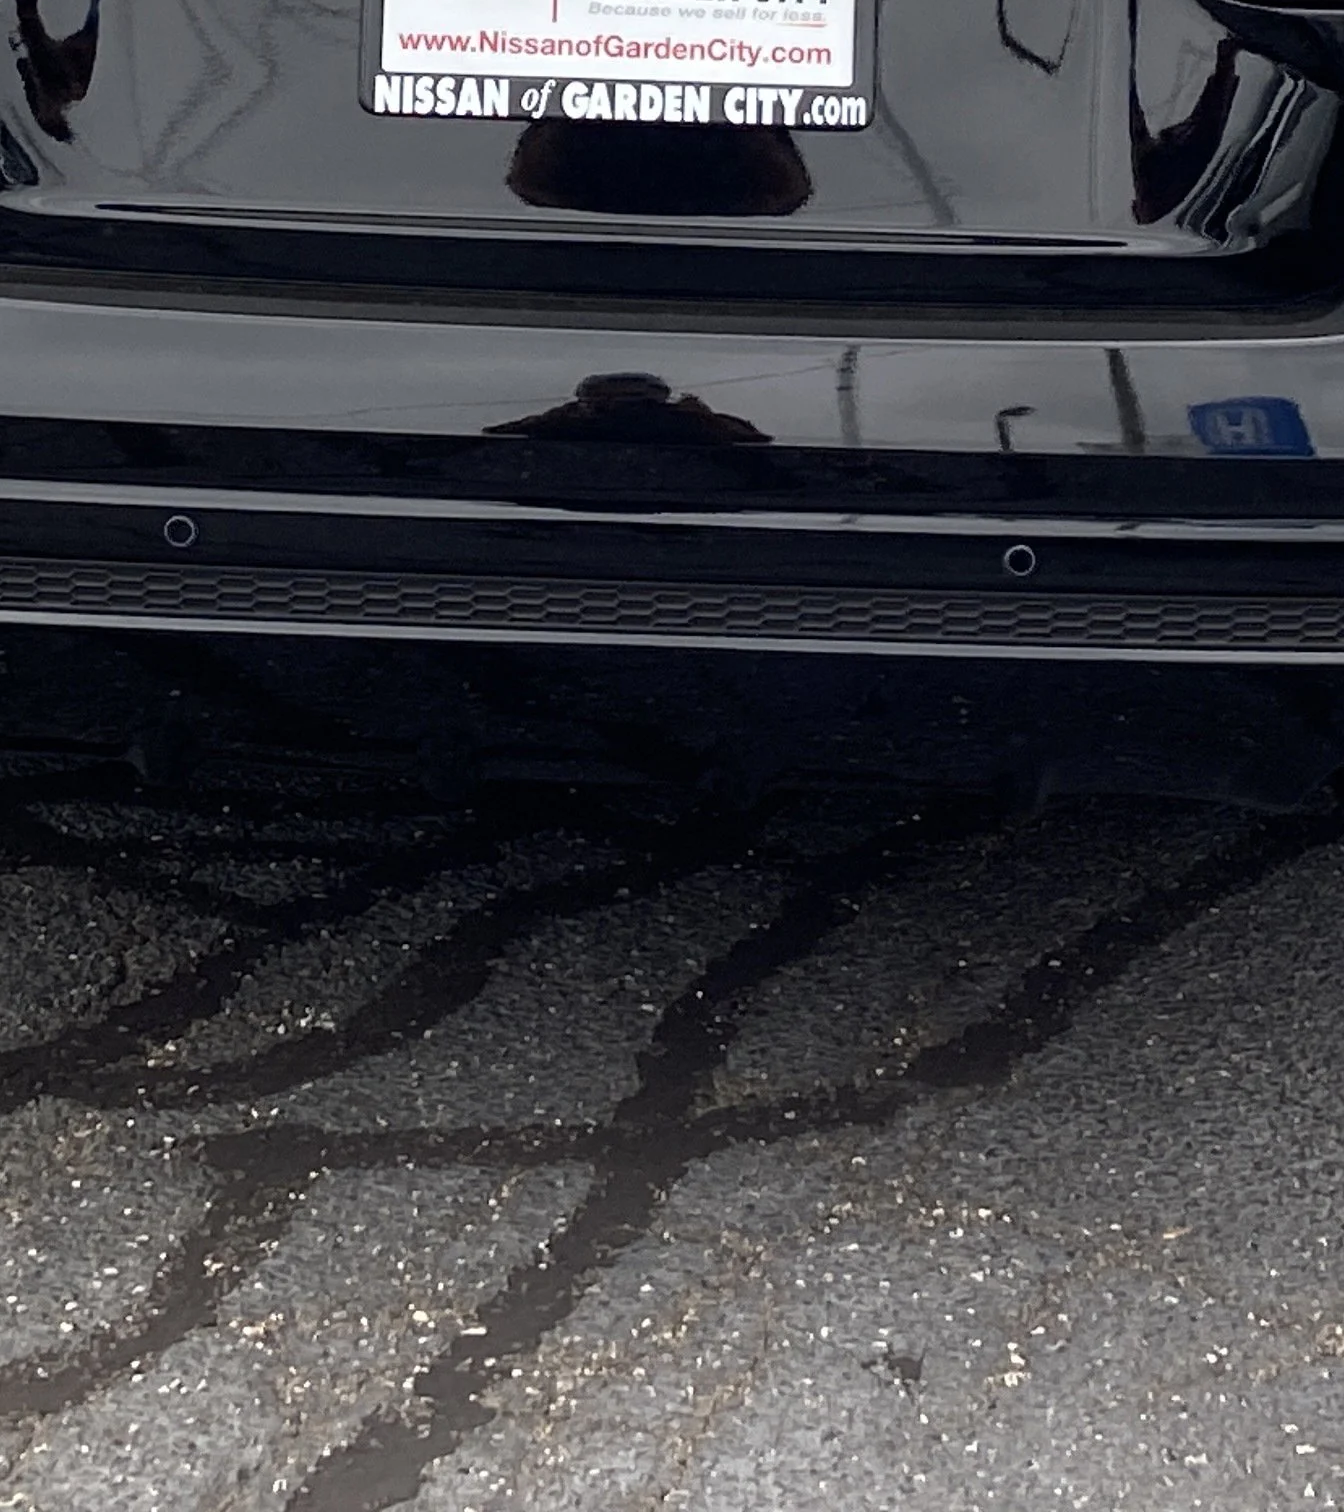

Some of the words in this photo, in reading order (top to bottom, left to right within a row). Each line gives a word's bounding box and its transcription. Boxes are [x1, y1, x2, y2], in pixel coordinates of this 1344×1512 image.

[588, 2, 671, 17] Because
[678, 7, 706, 19] we
[712, 7, 746, 20] sell
[752, 8, 778, 21] for
[399, 30, 832, 67] www.NissanofGardenCity.com
[374, 74, 510, 117] NISSAN
[520, 79, 556, 119] of
[561, 81, 711, 123] GARDEN
